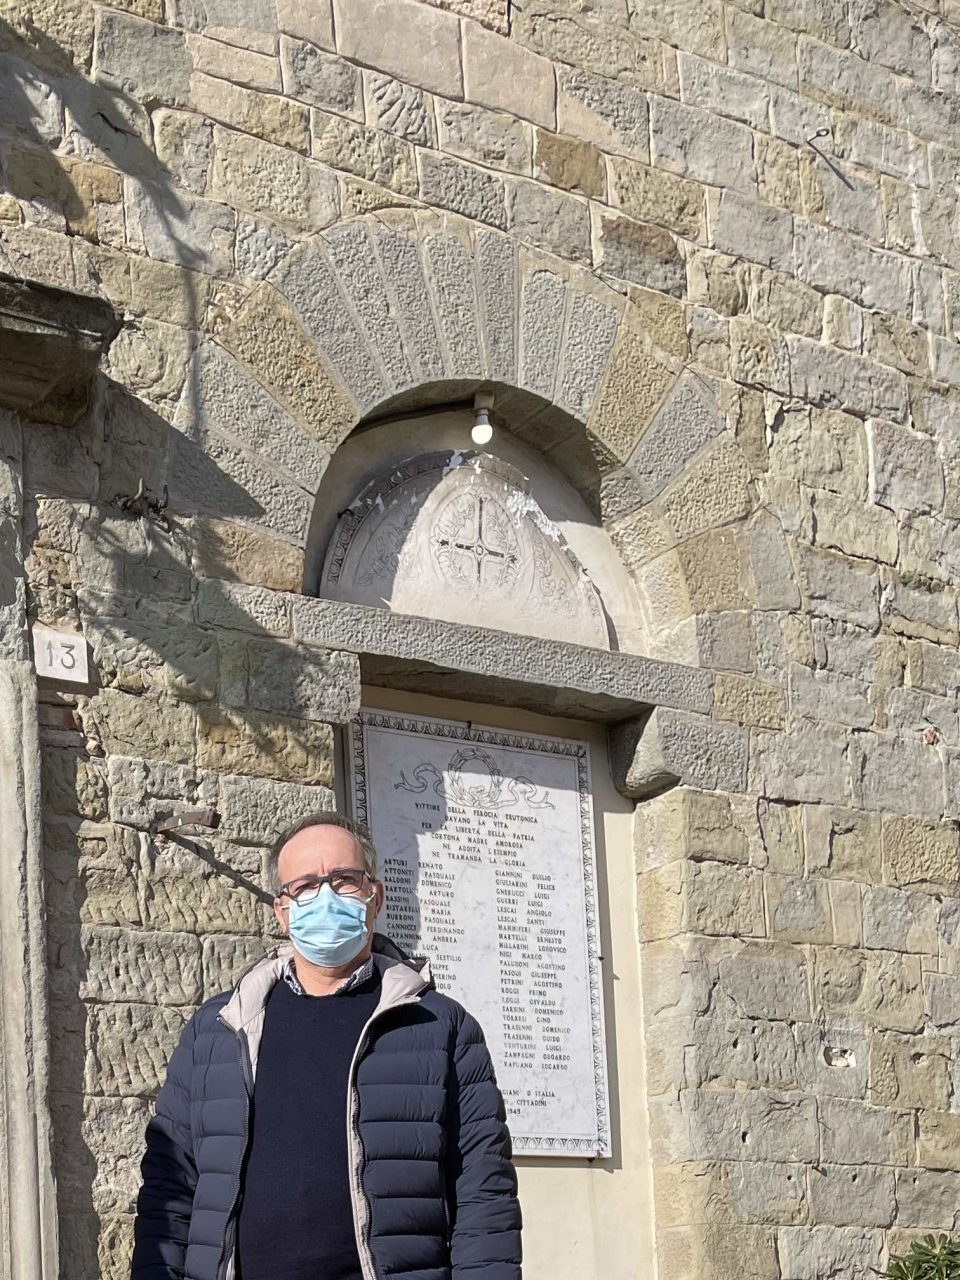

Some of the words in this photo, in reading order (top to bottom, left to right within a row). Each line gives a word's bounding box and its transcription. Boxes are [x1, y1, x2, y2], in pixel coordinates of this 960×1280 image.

[46, 640, 76, 670] 13
[414, 802, 440, 812] VITTIME
[448, 806, 466, 815] DELLA
[473, 809, 498, 819] FEROCIA
[505, 813, 538, 824] TEUTONICA
[444, 815, 471, 824] DAVANO
[494, 821, 508, 830] VITA
[488, 830, 506, 838] DELLA
[512, 832, 534, 842] PATRIA
[431, 832, 460, 842] CORTONA
[468, 836, 488, 846] MADRE
[496, 840, 523, 849] AMOROSA
[458, 844, 481, 854] ADDITA
[384, 858, 408, 866] ARTURI
[418, 862, 443, 870] RENATO
[448, 852, 482, 863] TRAMANDA
[504, 860, 526, 868] GLORIA
[424, 872, 456, 880] PASQUALE
[495, 870, 522, 878] GIANNINI
[422, 880, 452, 888] DOMENICO
[537, 883, 556, 891] FELICE
[420, 898, 451, 908] PASQUALE
[432, 908, 451, 916] MARIA
[526, 909, 552, 917] ANGIOLO
[424, 916, 456, 926] PASQUALE
[426, 926, 466, 934] FERDINANDO
[540, 928, 566, 936] GIUSEPPE
[432, 936, 458, 944] ANDREA
[537, 936, 562, 944] ERNESTO
[436, 954, 462, 962] SESTILIO
[537, 963, 566, 971] AGOSTINO
[531, 972, 557, 980] GIUSEPPE
[534, 981, 562, 989] AGOSTINO
